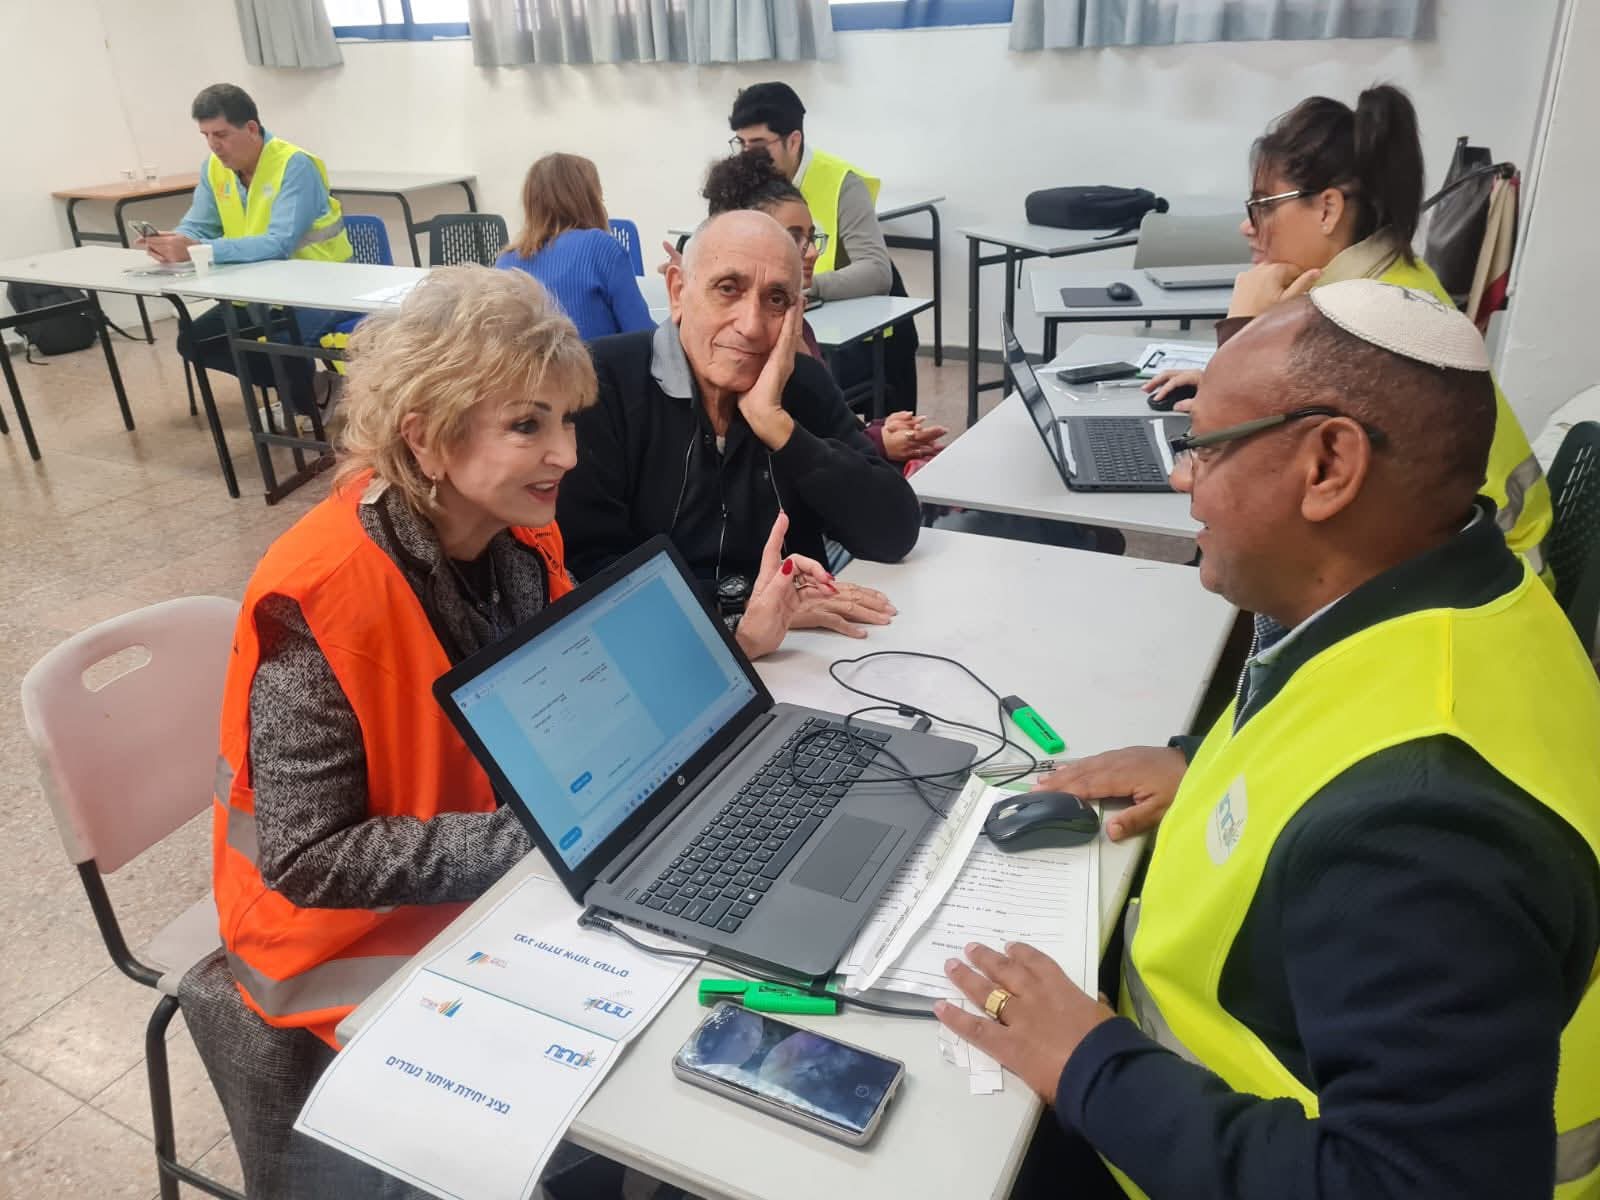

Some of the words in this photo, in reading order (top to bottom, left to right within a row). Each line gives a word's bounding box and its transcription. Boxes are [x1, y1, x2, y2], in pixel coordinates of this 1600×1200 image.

[385, 1054, 422, 1079] נעדרים
[425, 1070, 455, 1091] איתור
[454, 1083, 487, 1104] יחידת
[486, 1096, 511, 1115] נציג
